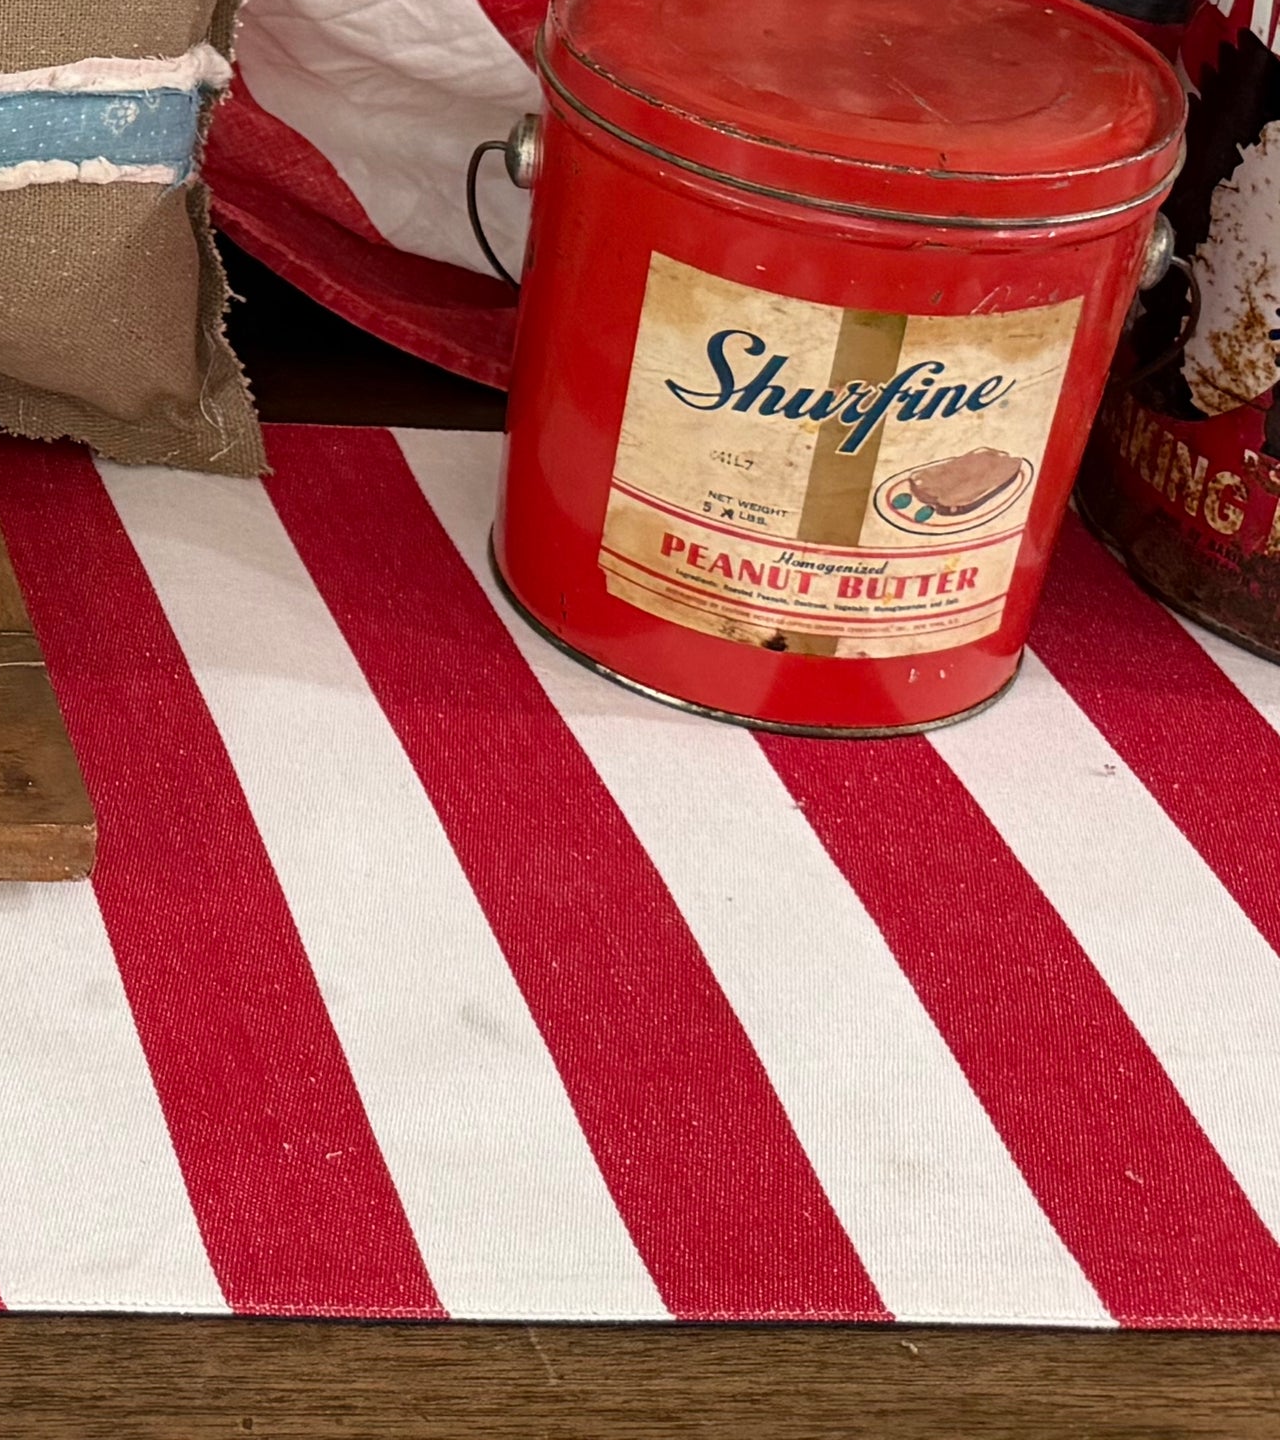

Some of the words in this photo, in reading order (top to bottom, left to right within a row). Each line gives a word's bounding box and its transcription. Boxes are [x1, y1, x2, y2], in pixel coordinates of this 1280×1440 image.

[664, 329, 1016, 453] Shurfine
[702, 500, 712, 513] 5
[707, 489, 733, 504] NET
[737, 499, 789, 517] WEIGHT
[660, 532, 820, 595] PEANUT
[837, 566, 979, 600] BUTTER
[773, 550, 889, 576] Homogenized
